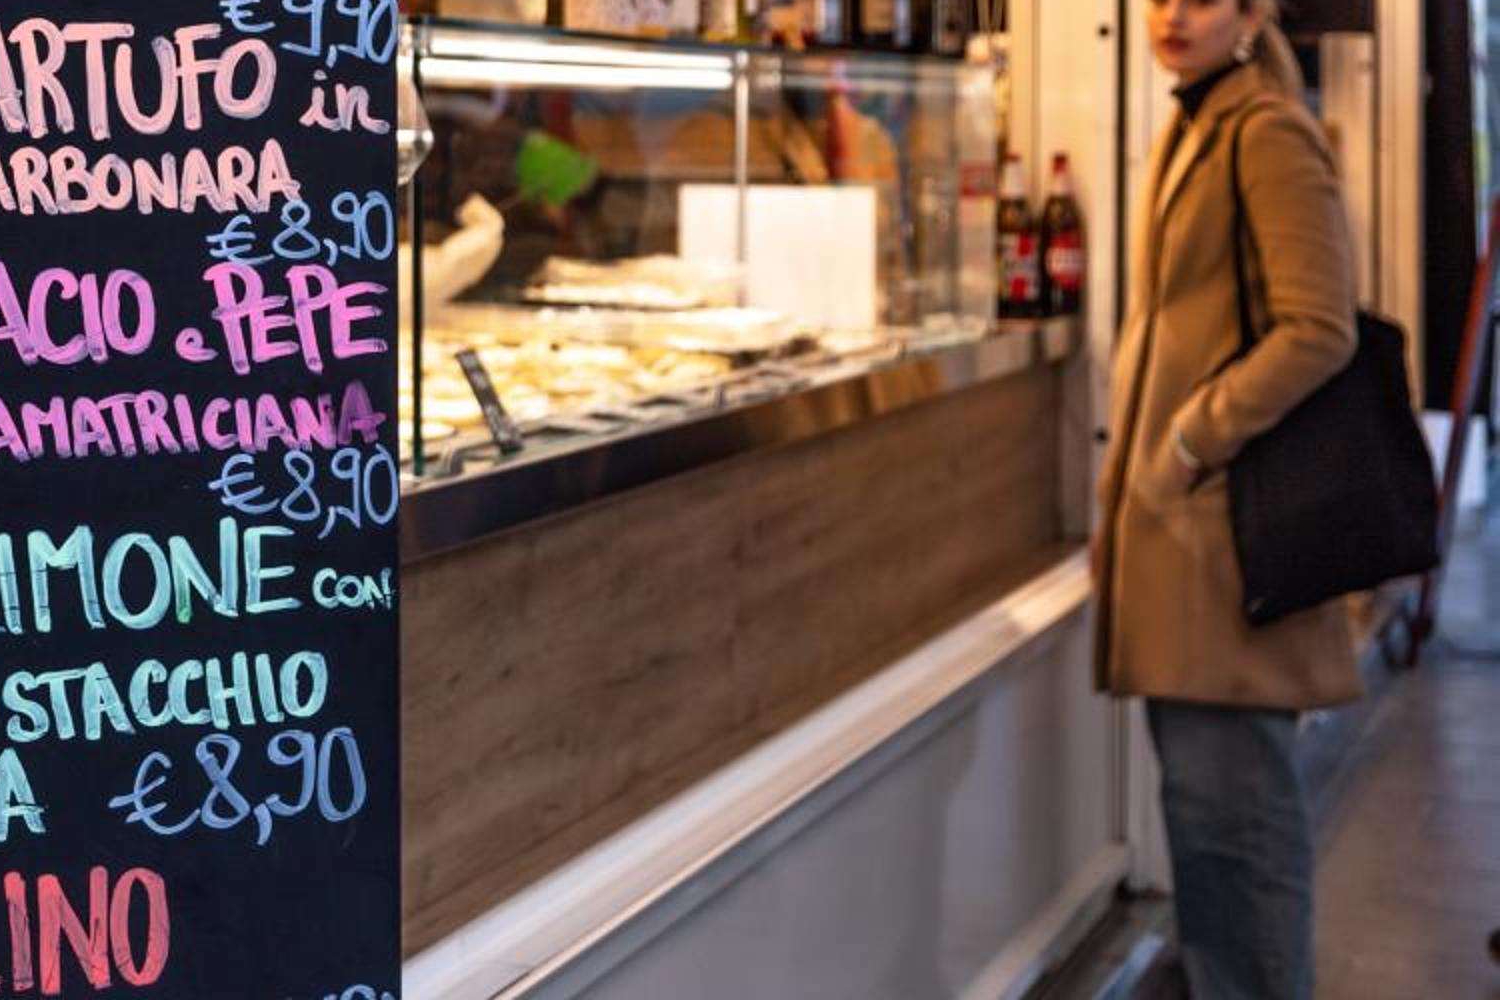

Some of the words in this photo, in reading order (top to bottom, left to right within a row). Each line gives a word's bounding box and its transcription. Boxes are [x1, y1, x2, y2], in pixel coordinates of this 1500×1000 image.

[299, 68, 390, 135] in
[203, 260, 389, 376] PEPE
[312, 566, 394, 611] CON
